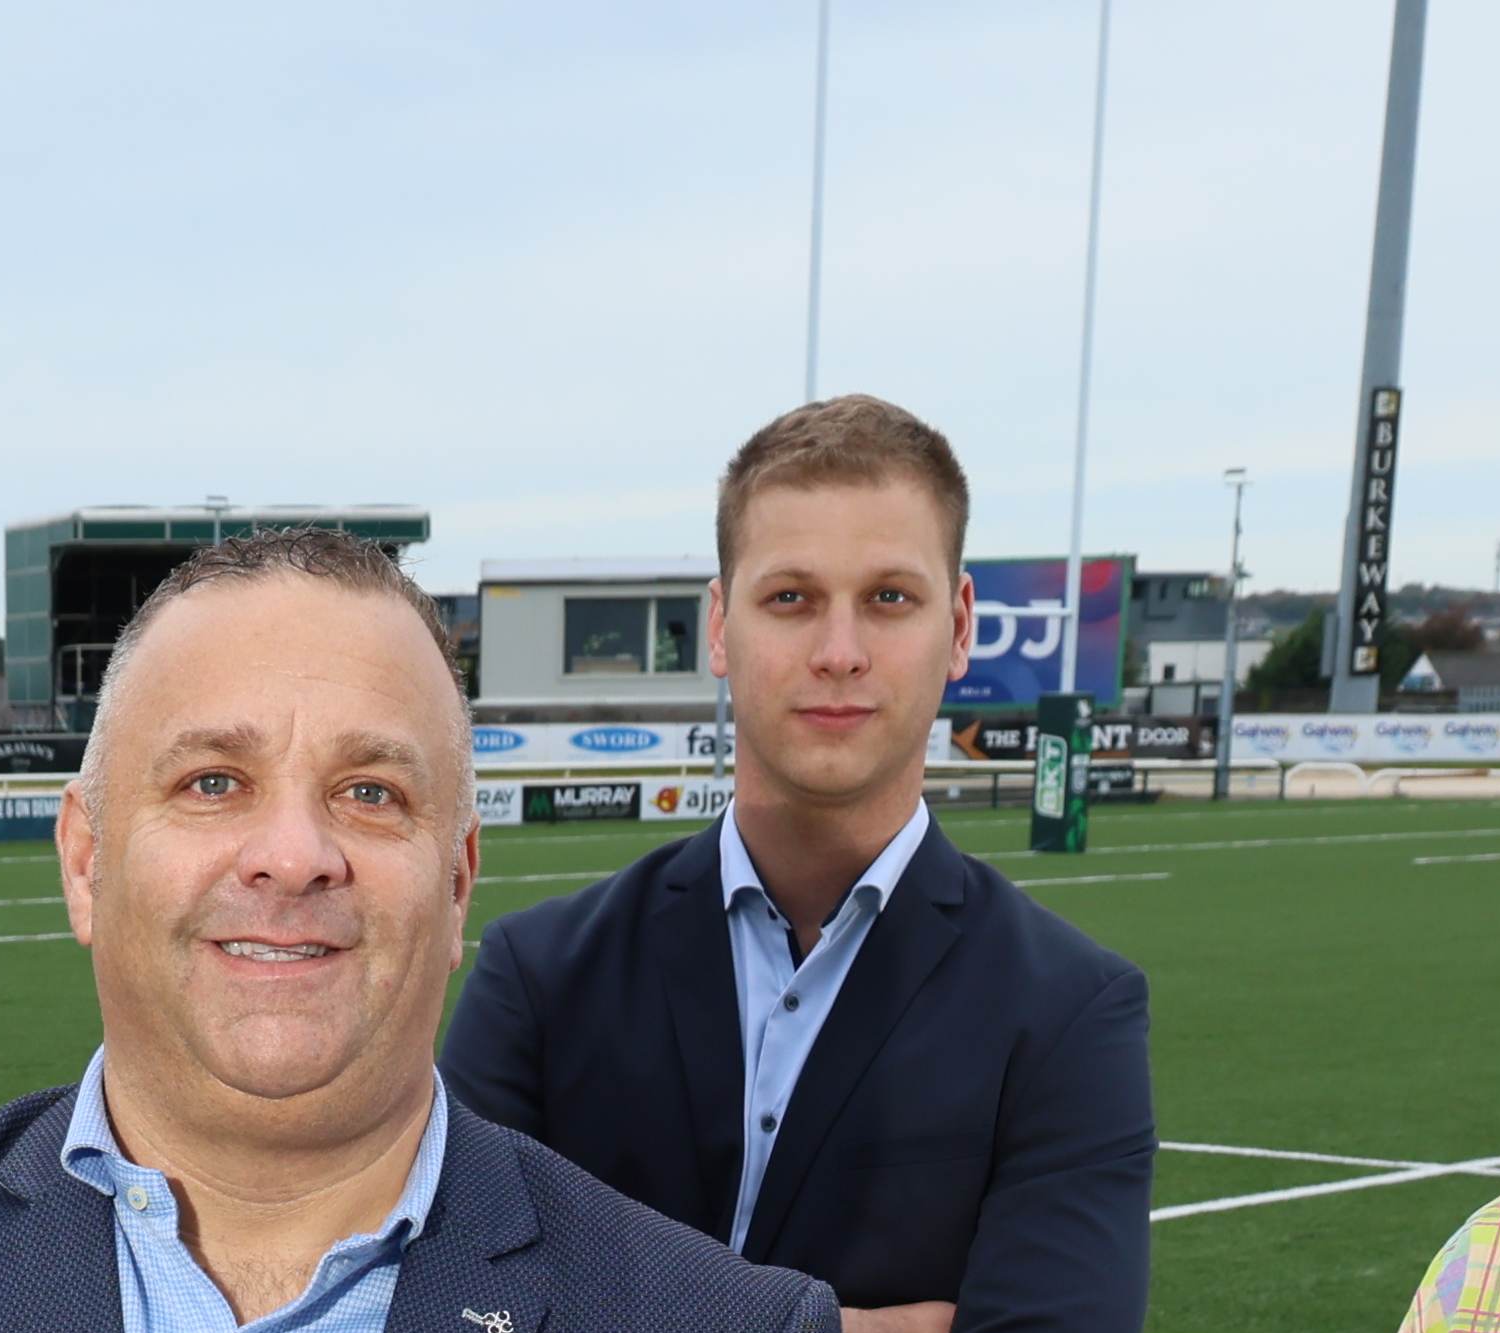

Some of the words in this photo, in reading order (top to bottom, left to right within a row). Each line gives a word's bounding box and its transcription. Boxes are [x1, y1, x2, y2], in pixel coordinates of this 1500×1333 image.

[1359, 420, 1394, 643] BURKEWAY
[581, 732, 652, 747] SWORD
[984, 729, 1020, 748] THE
[1137, 727, 1189, 743] DOOR
[476, 789, 515, 807] RAY
[553, 785, 636, 807] MURRAY
[687, 784, 734, 813] ajp
